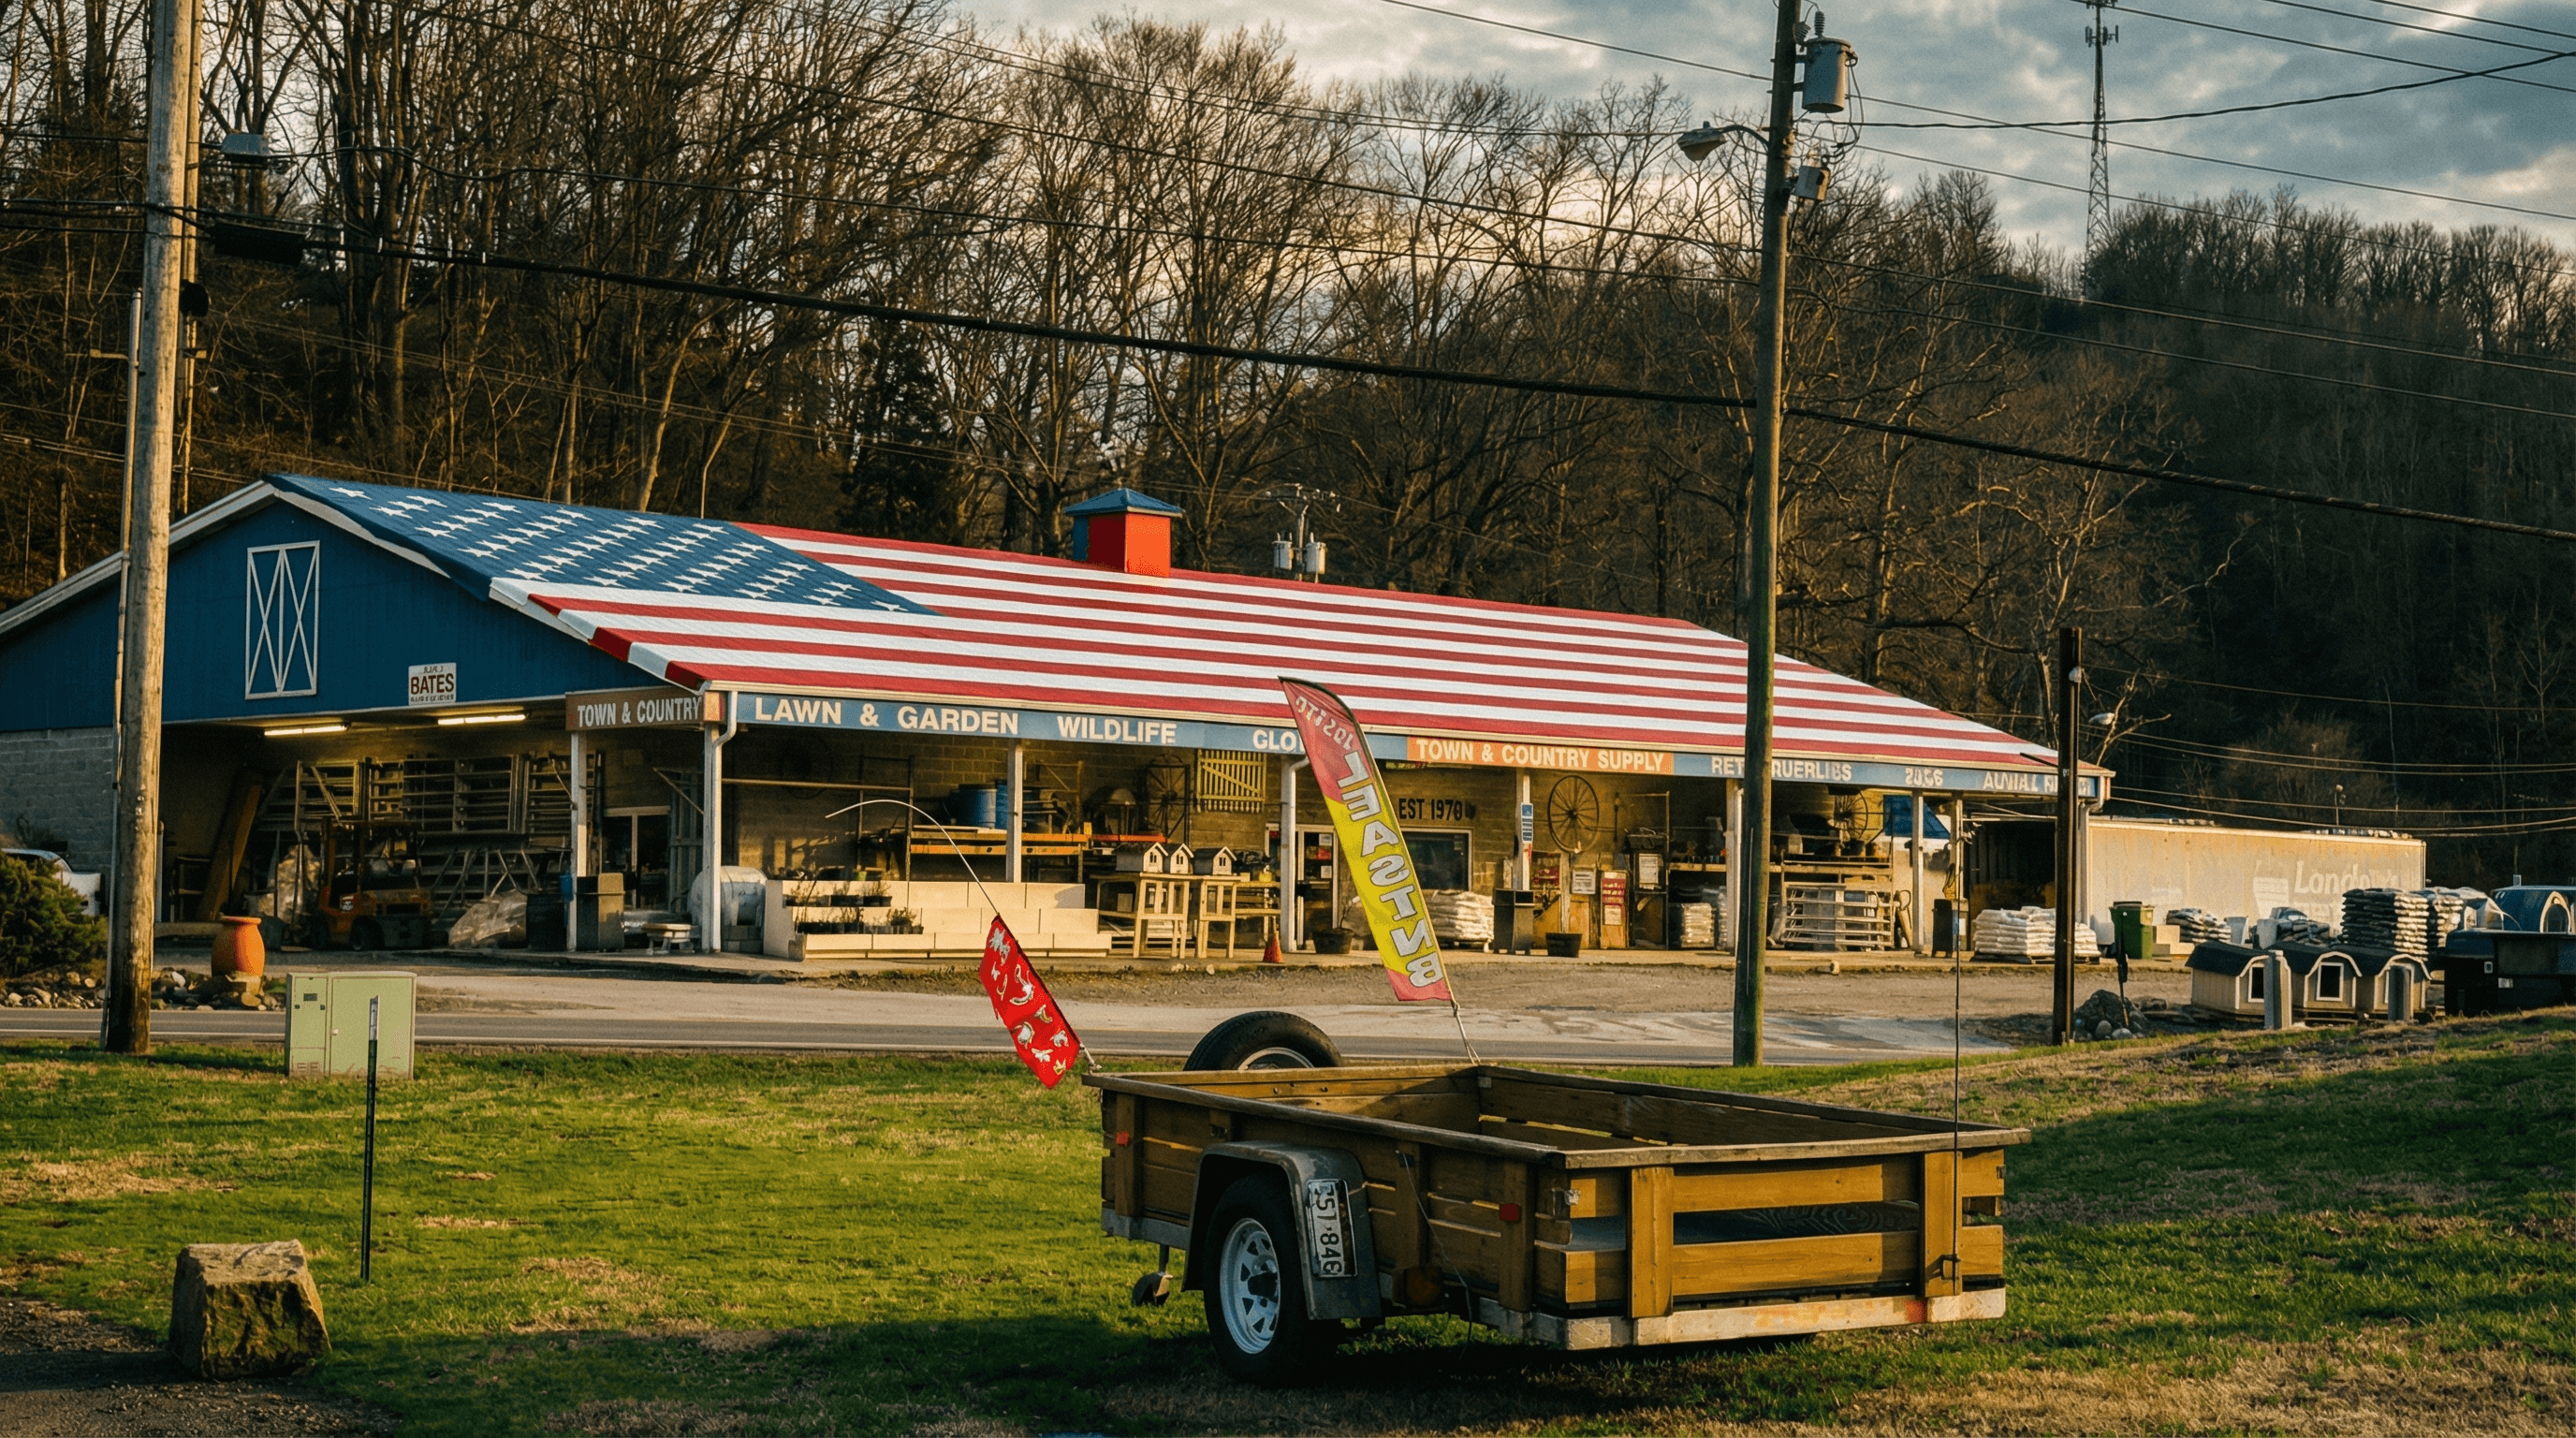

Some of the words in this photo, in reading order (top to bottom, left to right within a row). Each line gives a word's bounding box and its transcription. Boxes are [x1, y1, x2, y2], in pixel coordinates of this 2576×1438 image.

[410, 673, 454, 695] BATES
[578, 703, 616, 727] TOWN
[622, 701, 632, 724] &
[637, 697, 701, 724] COUNTRY
[755, 697, 842, 725] LAWN
[859, 703, 879, 727] &
[898, 706, 1018, 735] GARDEN
[1057, 715, 1177, 744] WILDLIFE
[1416, 739, 1473, 761] TOWN
[1482, 744, 1494, 762] &
[1501, 744, 1589, 768] COUNTRY
[1598, 750, 1664, 771] SUPPLY
[1398, 799, 1425, 819] EST
[1430, 799, 1463, 821] 1970
